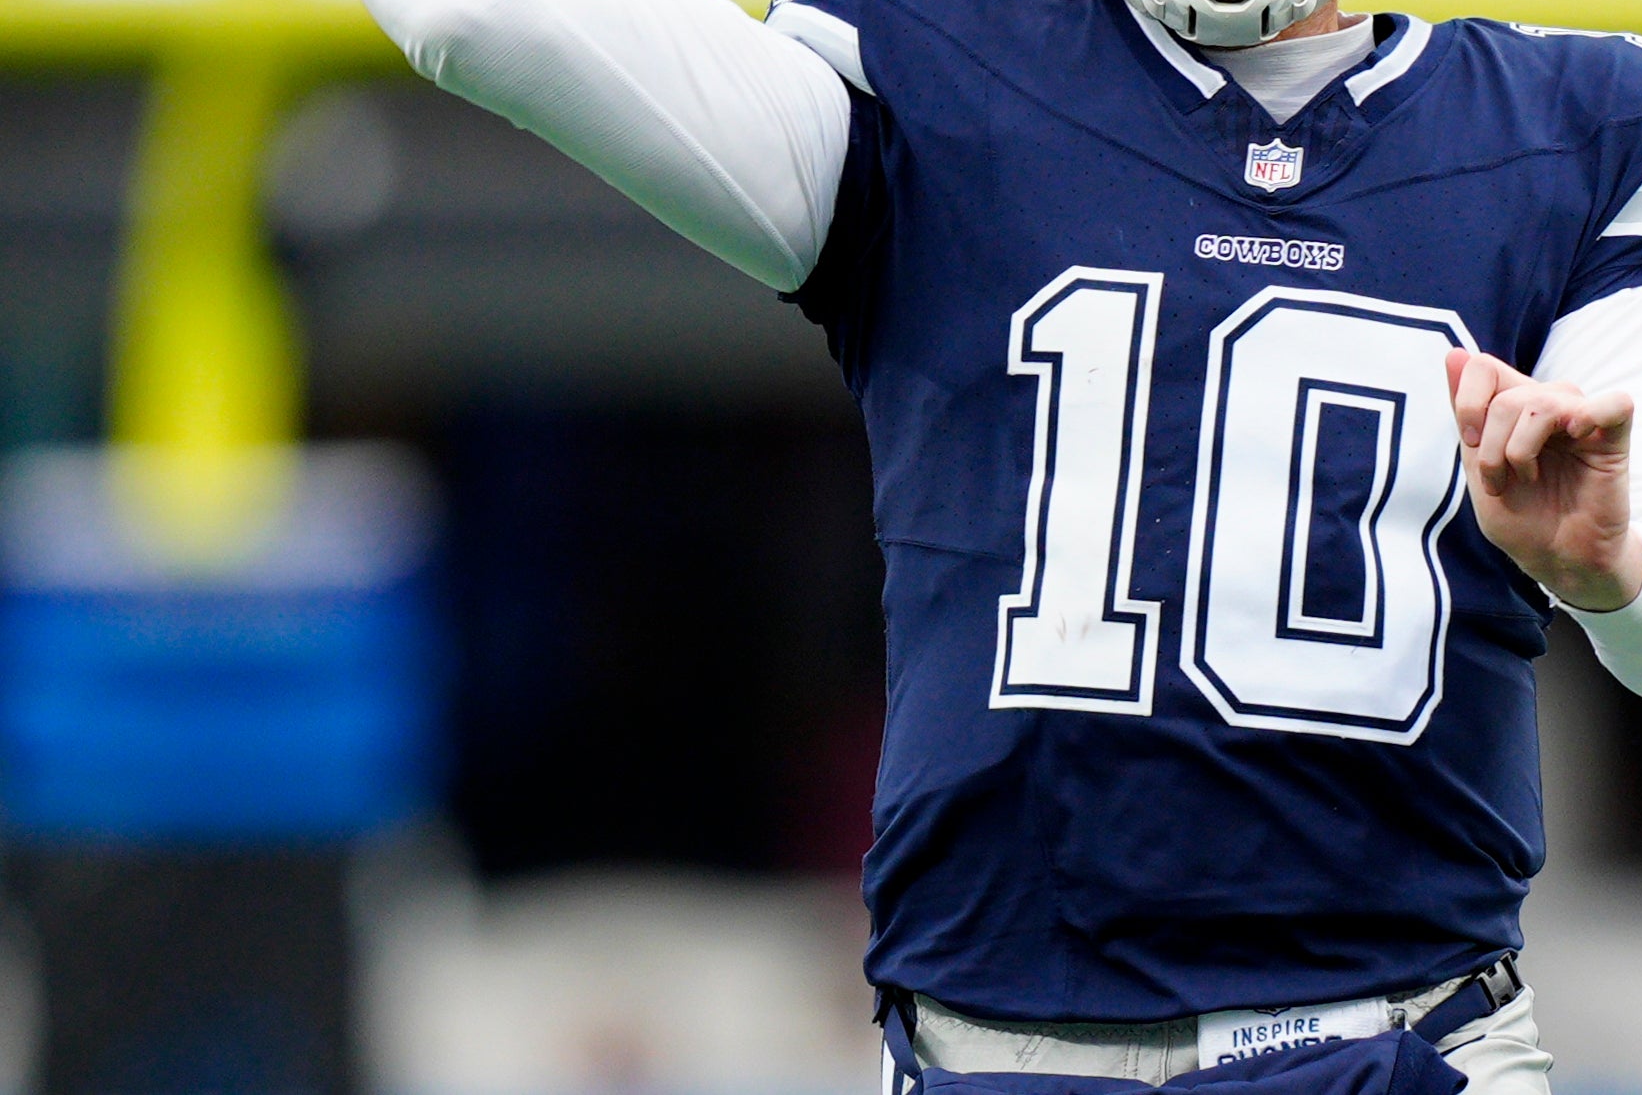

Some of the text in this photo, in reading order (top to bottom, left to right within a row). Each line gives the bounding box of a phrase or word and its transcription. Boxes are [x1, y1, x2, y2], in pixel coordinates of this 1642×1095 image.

[1254, 161, 1291, 181] NFL
[1194, 234, 1344, 271] COWBOYS
[989, 265, 1478, 746] 10
[1232, 1018, 1320, 1047] INSPIRE
